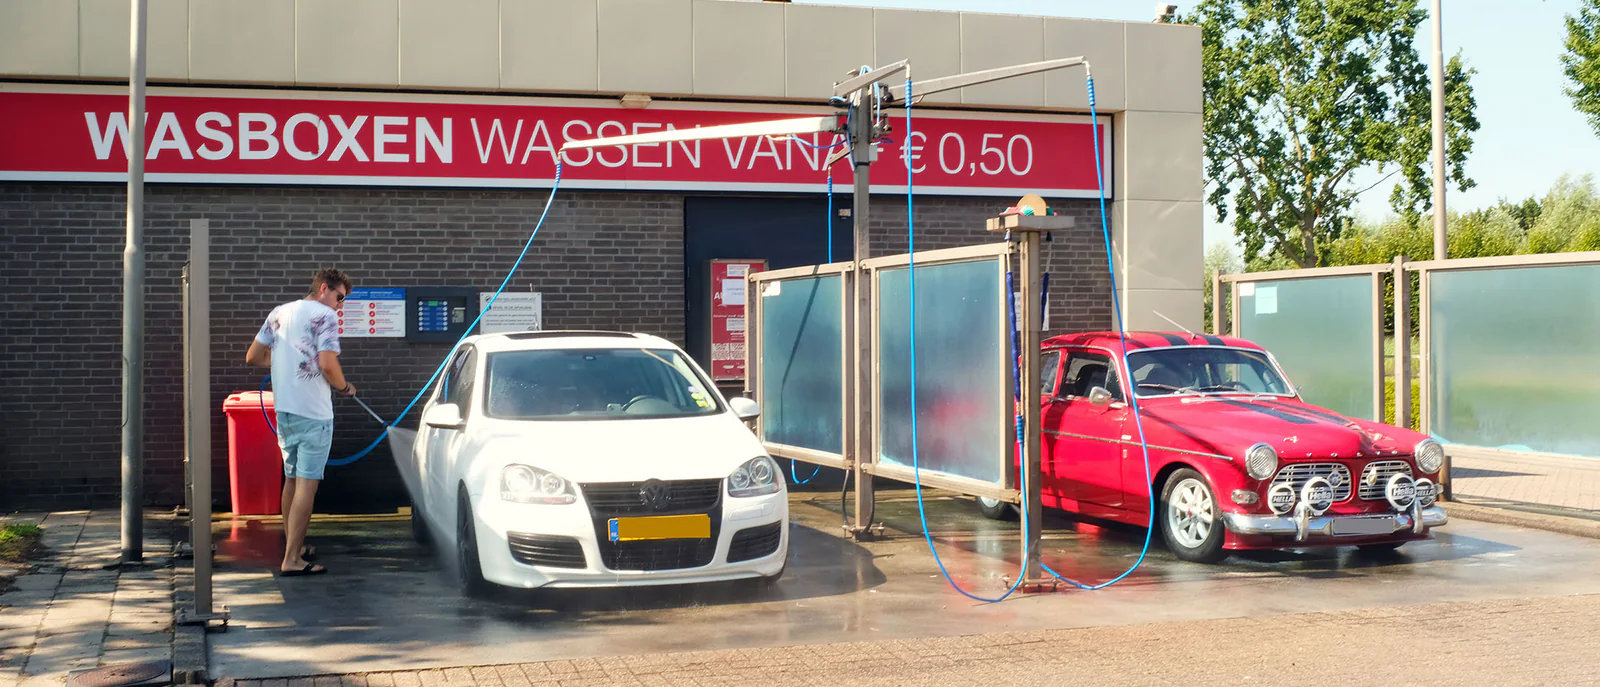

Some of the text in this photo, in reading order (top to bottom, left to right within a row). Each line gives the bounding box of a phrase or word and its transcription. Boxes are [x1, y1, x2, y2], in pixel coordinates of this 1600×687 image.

[84, 111, 1033, 177] WASBOXEN WASSEN VANA € 0,50
[1273, 494, 1295, 503] HELLA
